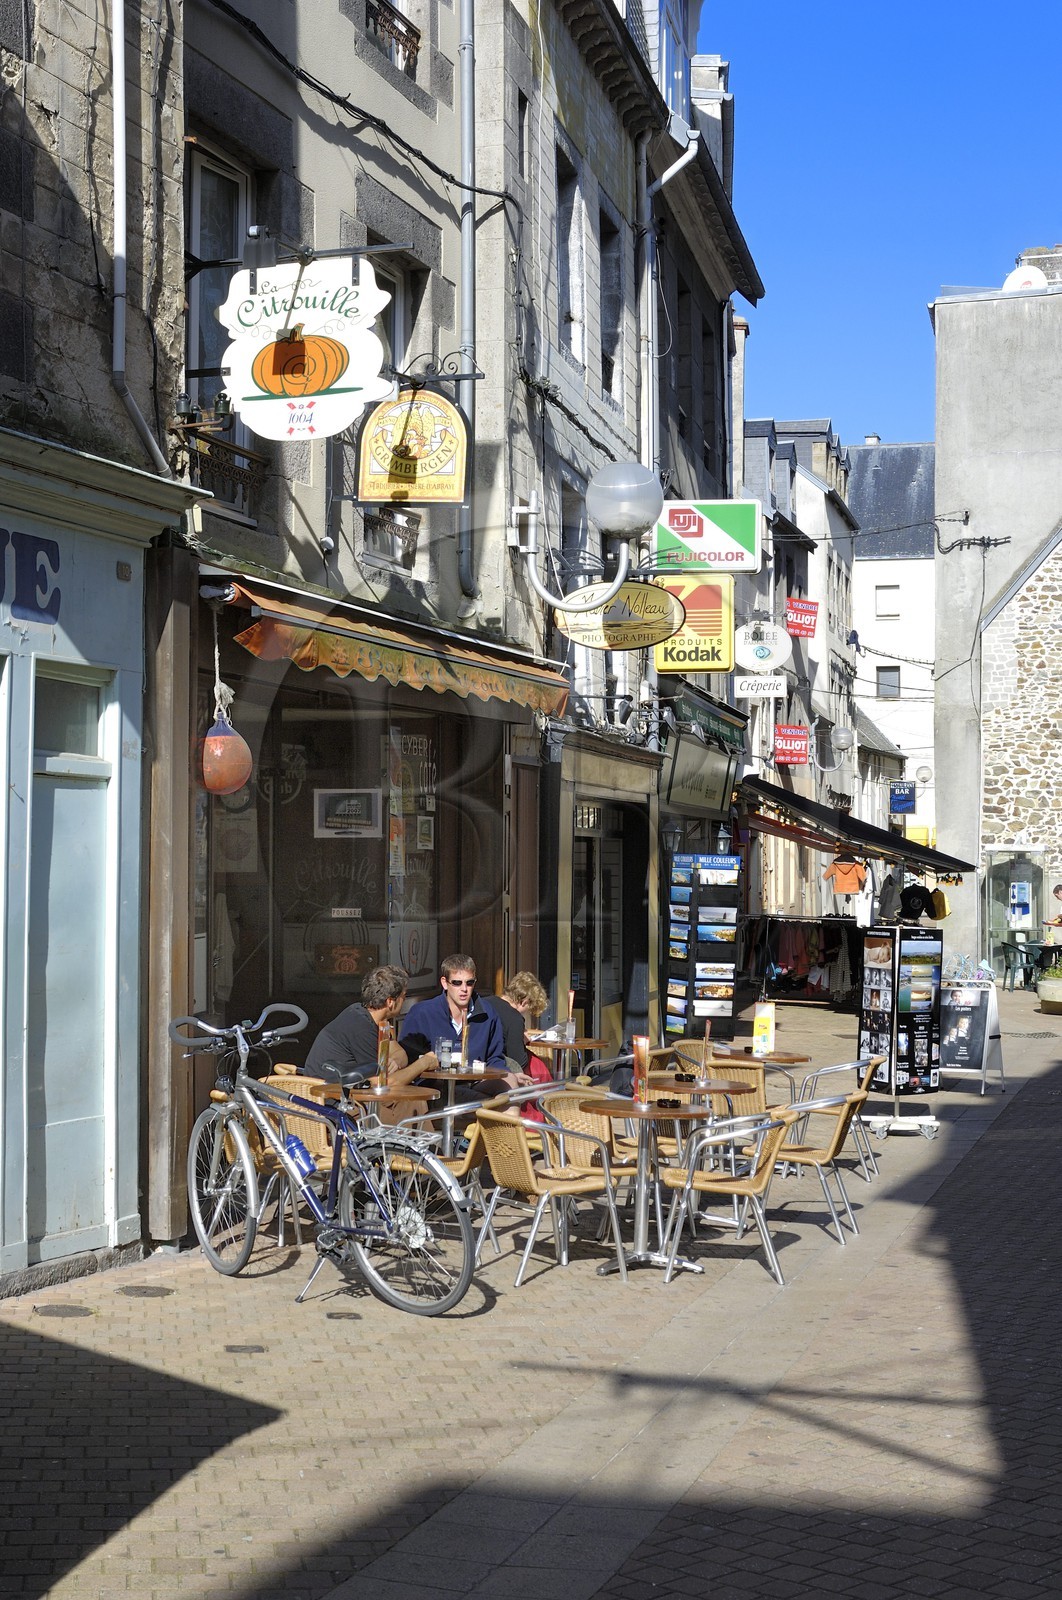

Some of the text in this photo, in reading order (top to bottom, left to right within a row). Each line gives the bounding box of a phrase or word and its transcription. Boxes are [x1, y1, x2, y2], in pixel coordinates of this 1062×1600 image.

[258, 281, 280, 297] La
[237, 286, 361, 327] Citrouille
[375, 446, 452, 474] GRIMBERGEN
[669, 512, 699, 533] FUJI
[667, 551, 745, 563] FUJICOLOR
[786, 611, 817, 626] OLLIOT
[582, 633, 656, 643] PHOTOGRAPHE
[663, 638, 723, 646] PRODUITS
[663, 645, 722, 662] Kodak
[739, 680, 782, 694] Crêperie
[401, 734, 429, 758] CYBER
[775, 739, 807, 751] OLLIOT
[699, 856, 712, 864] MILLE
